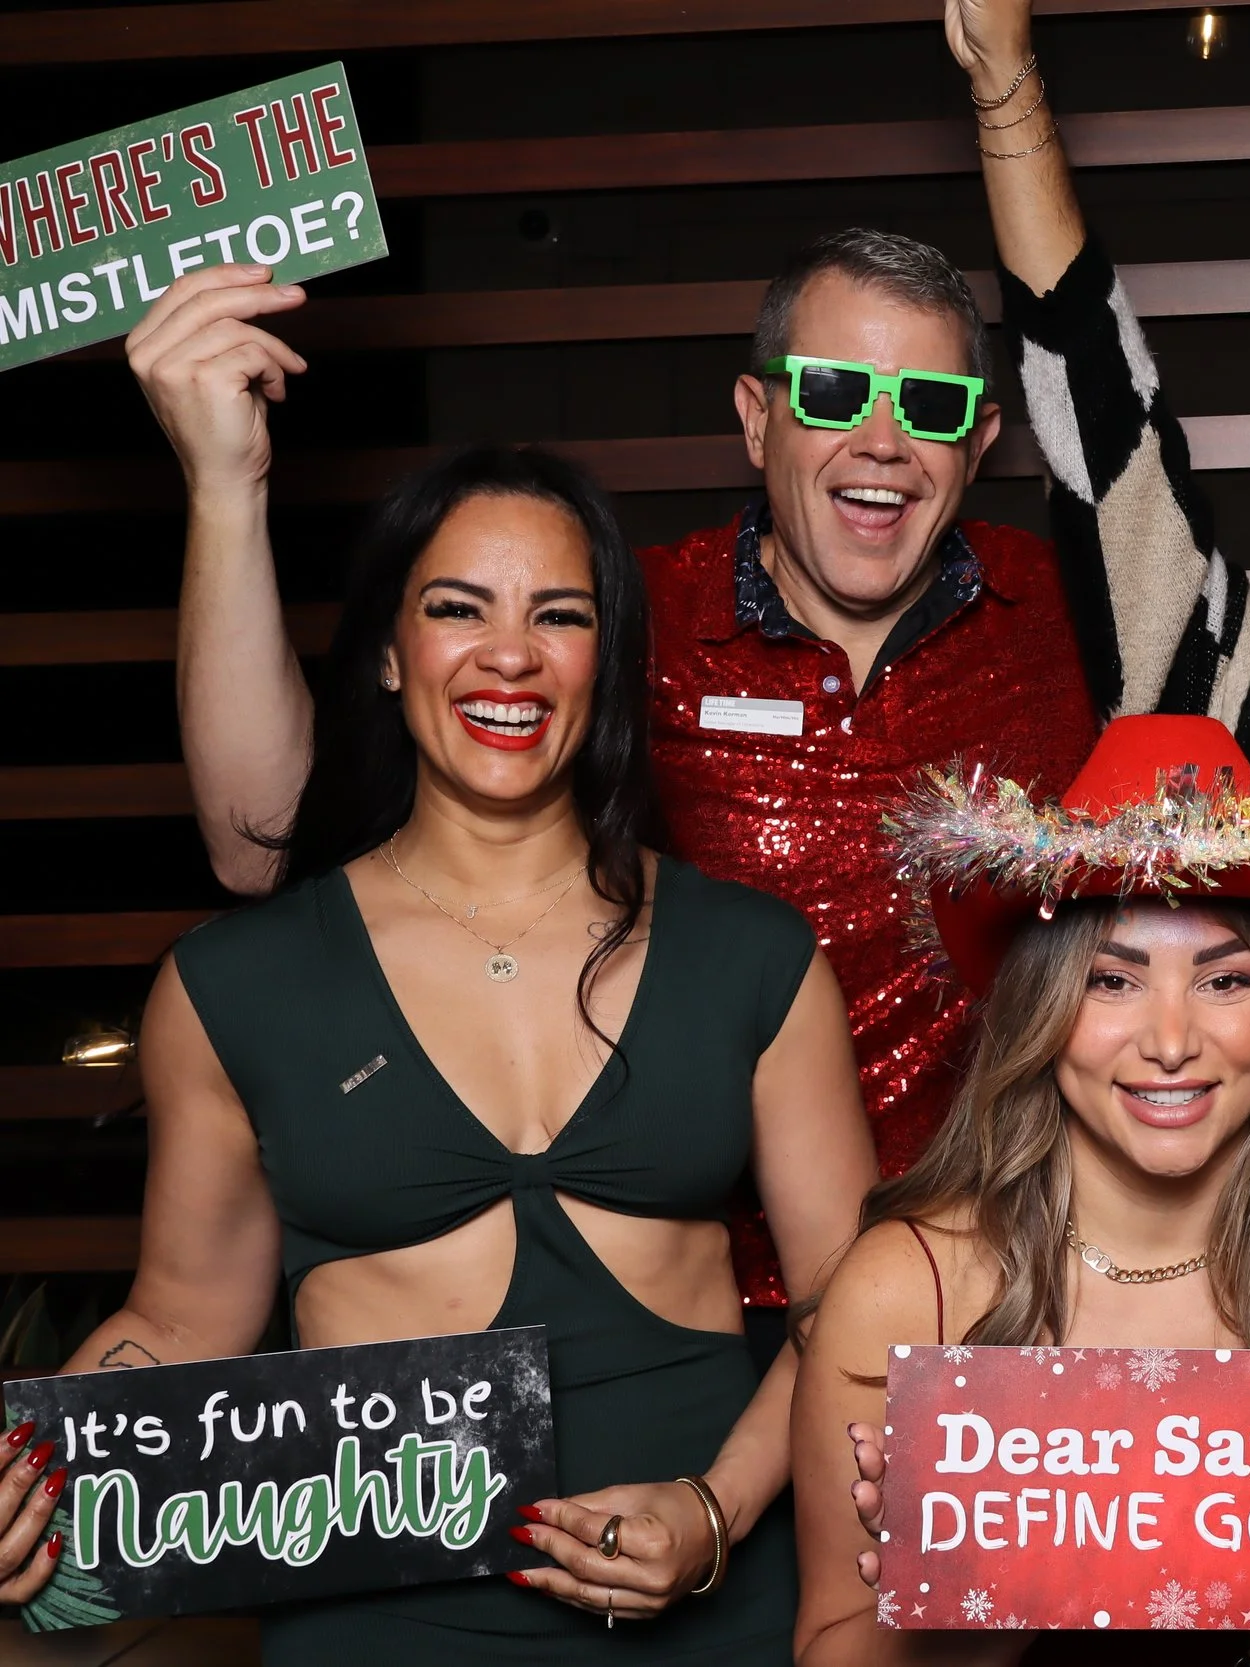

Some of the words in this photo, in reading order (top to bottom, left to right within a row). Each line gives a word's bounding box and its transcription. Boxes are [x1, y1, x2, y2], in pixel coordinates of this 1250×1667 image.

[234, 82, 357, 189] THE
[64, 1411, 171, 1462] It's
[198, 1390, 307, 1461] fun
[331, 1382, 397, 1430] to
[421, 1377, 492, 1425] be
[935, 1413, 1134, 1475] Dear
[73, 1432, 507, 1570] Naughty
[921, 1488, 1165, 1554] DEFINE
